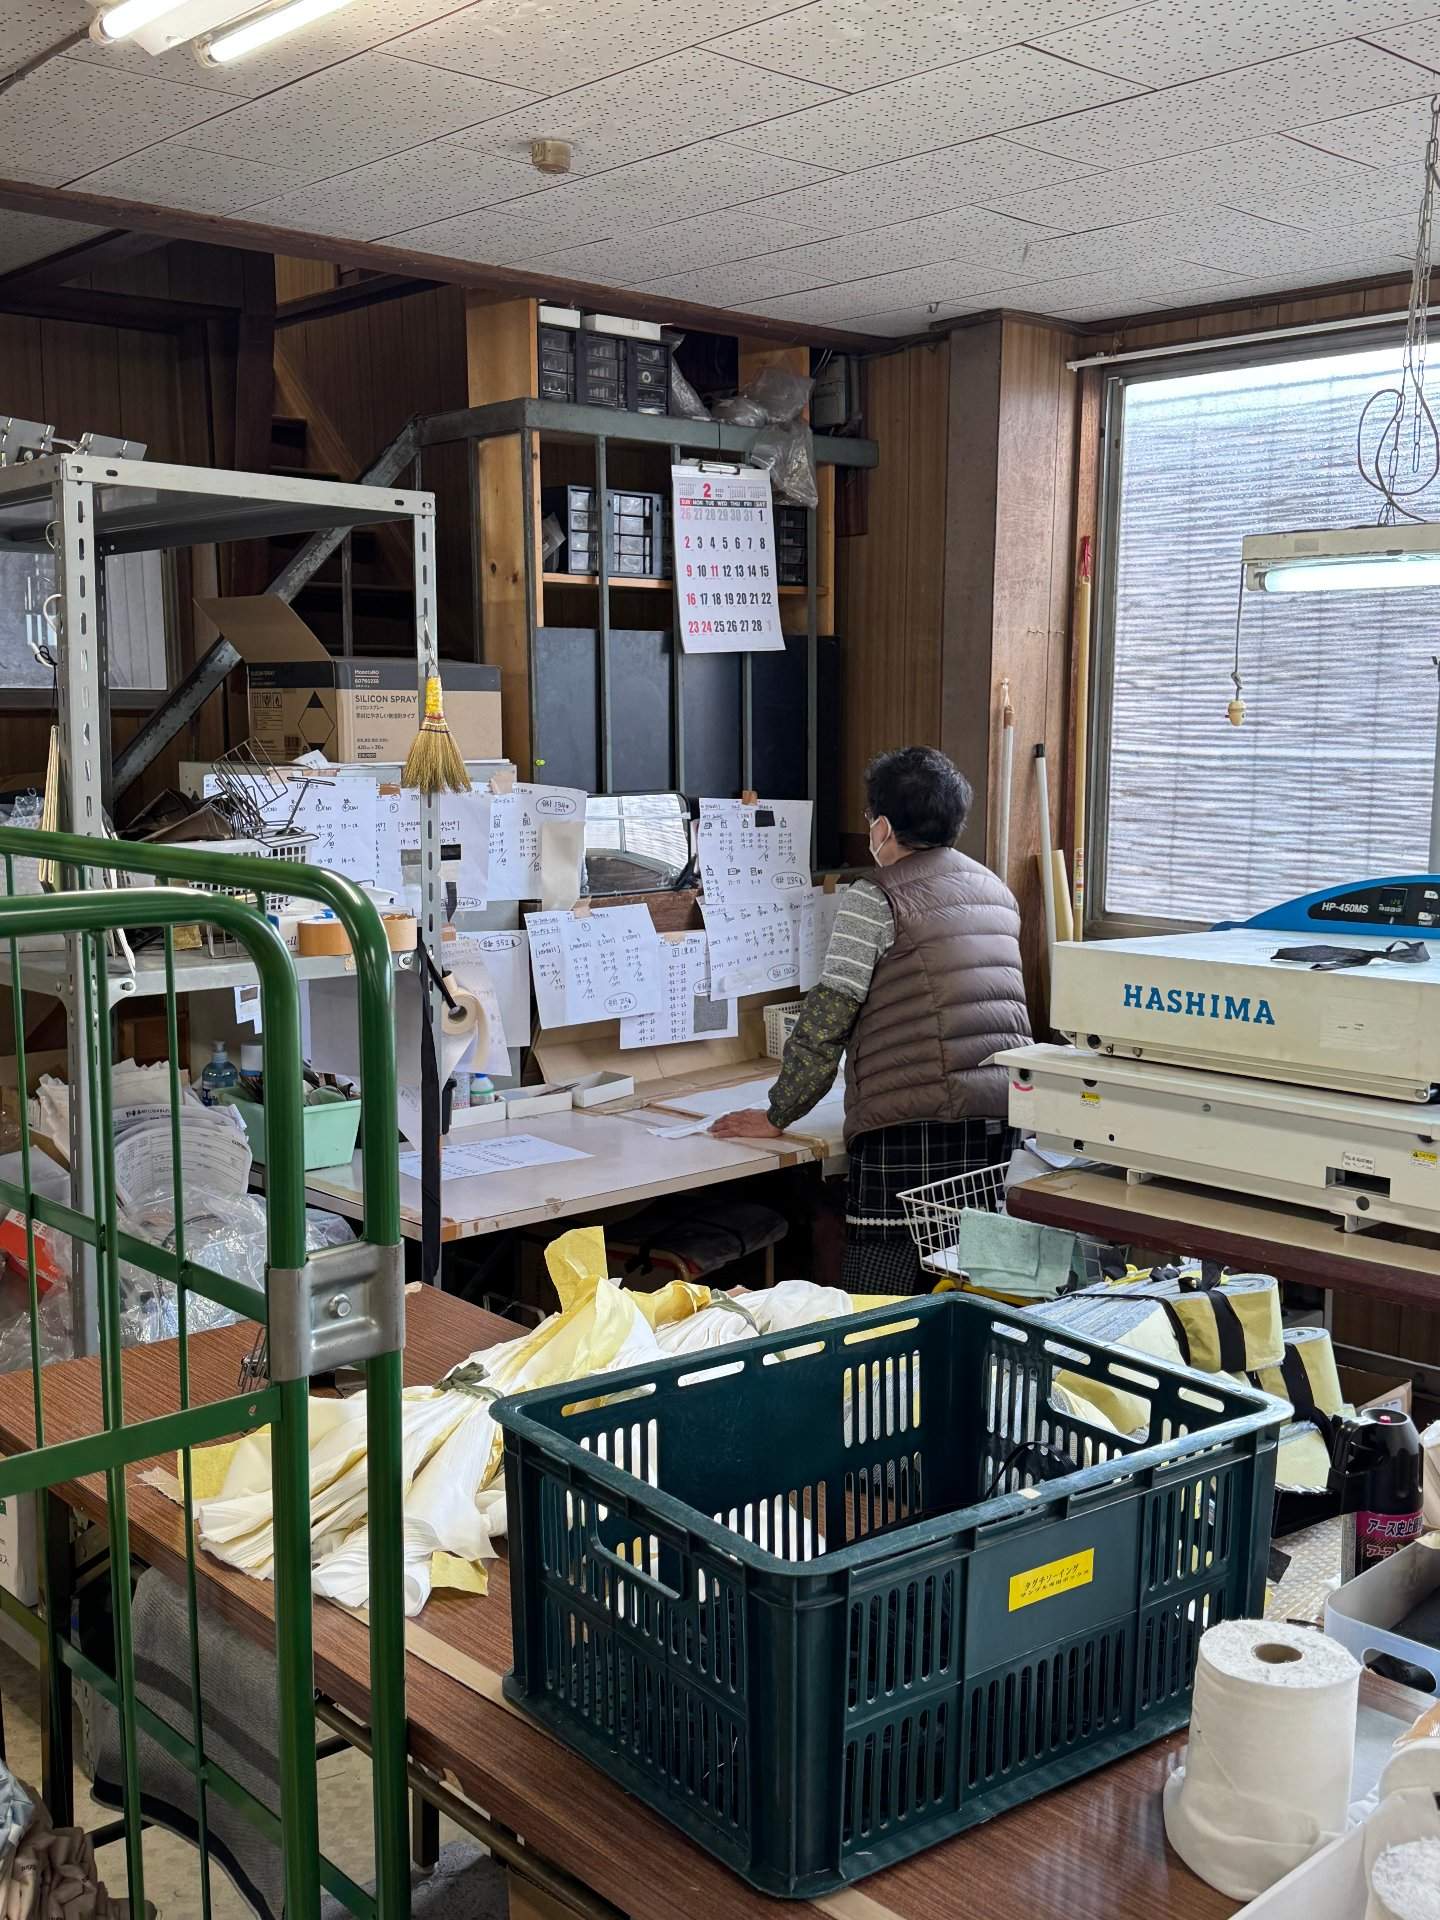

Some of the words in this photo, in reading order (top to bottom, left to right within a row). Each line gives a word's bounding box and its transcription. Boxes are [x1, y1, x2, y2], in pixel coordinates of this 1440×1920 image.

[702, 483, 712, 498] 2
[680, 507, 691, 520] 26
[694, 508, 702, 520] 27
[706, 508, 716, 520] 28
[718, 508, 728, 520] 29
[730, 508, 741, 521] 30
[744, 509, 752, 521] 31
[758, 509, 763, 522] 1
[685, 536, 690, 549] 2
[697, 536, 703, 549] 3
[710, 536, 715, 549] 4
[722, 537, 728, 550] 5
[735, 537, 740, 550] 6
[748, 537, 752, 550] 7
[760, 537, 765, 550] 8
[687, 564, 692, 577] 9
[697, 565, 706, 577] 10
[710, 565, 719, 577] 11
[723, 565, 731, 577] 12
[735, 565, 744, 578] 13
[747, 565, 756, 578] 14
[760, 565, 769, 578] 15
[686, 593, 696, 606] 16
[700, 593, 708, 606] 17
[712, 593, 721, 605] 18
[724, 593, 734, 605] 19
[736, 593, 747, 605] 20
[750, 592, 759, 605] 21
[761, 592, 771, 605] 22
[688, 621, 699, 633] 23
[702, 621, 712, 633] 24
[714, 620, 725, 633] 25
[727, 620, 738, 633] 26
[740, 620, 749, 632] 27
[752, 620, 762, 632] 28
[355, 694, 388, 702] SILICON
[1321, 902, 1369, 914] HP-450MS
[1123, 984, 1276, 1026] HASHIMA
